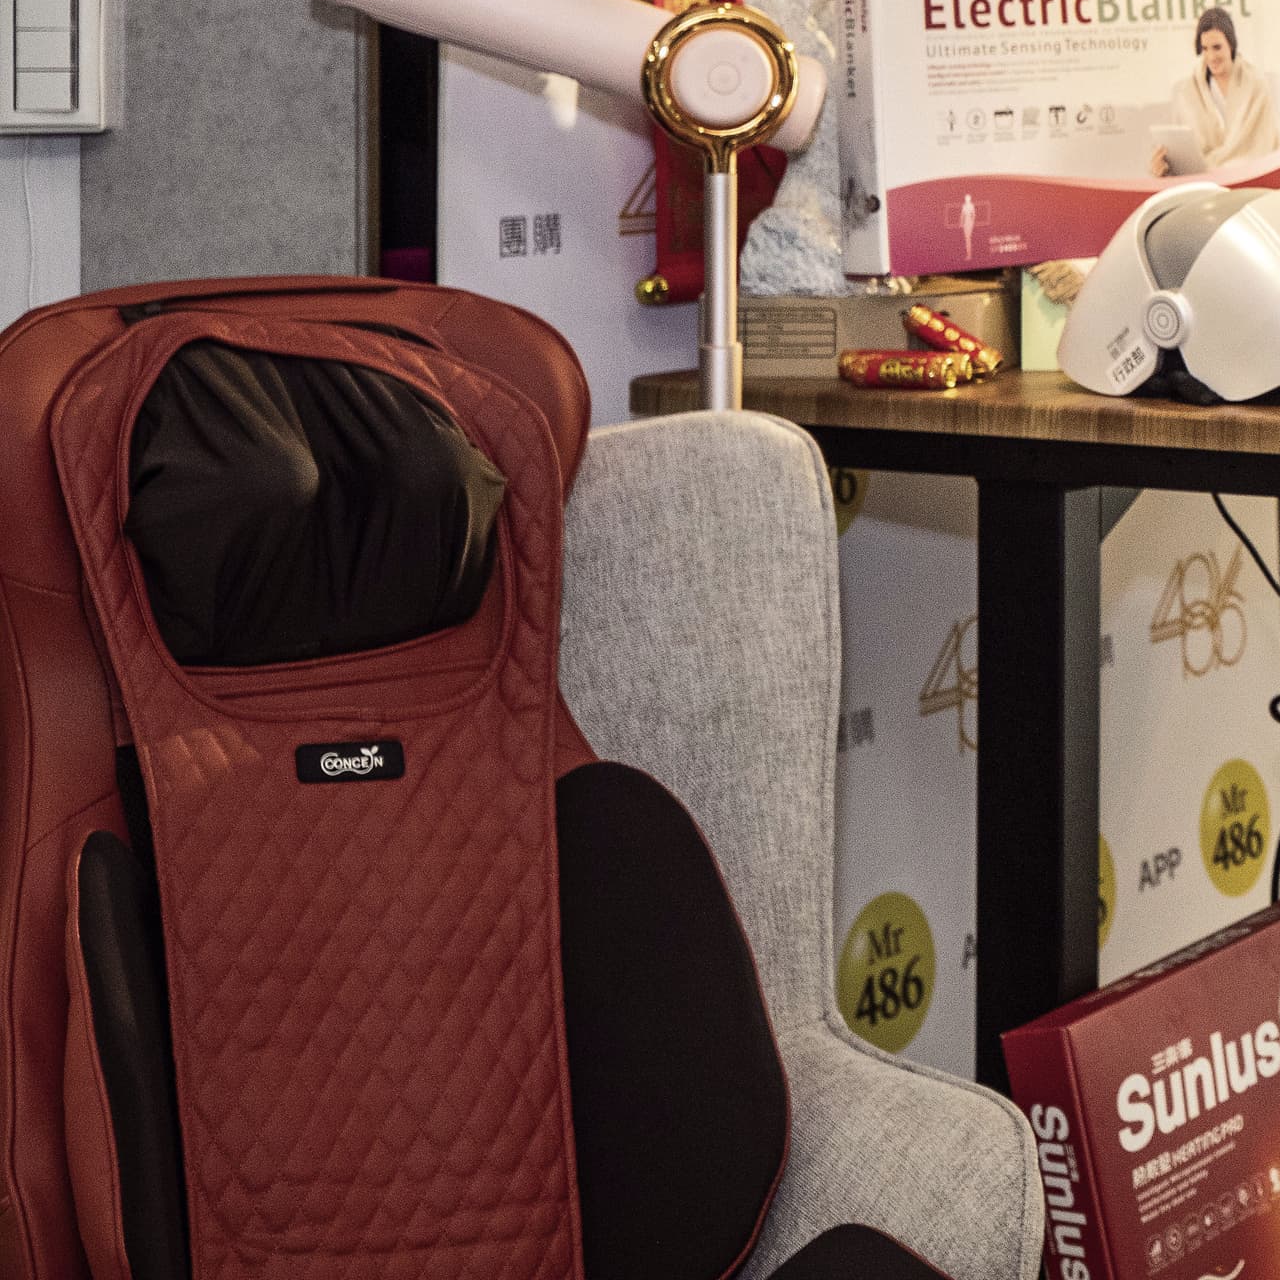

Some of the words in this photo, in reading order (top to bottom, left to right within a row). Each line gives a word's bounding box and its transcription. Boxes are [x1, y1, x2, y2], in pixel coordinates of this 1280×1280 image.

[925, 43, 998, 59] Ultimate
[1000, 39, 1062, 57] Sensing
[1064, 35, 1149, 55] Technology
[1219, 784, 1248, 814] Mr
[1212, 814, 1263, 871] 486
[1138, 847, 1182, 892] APP
[866, 923, 904, 965] Mr
[855, 955, 924, 1024] 486
